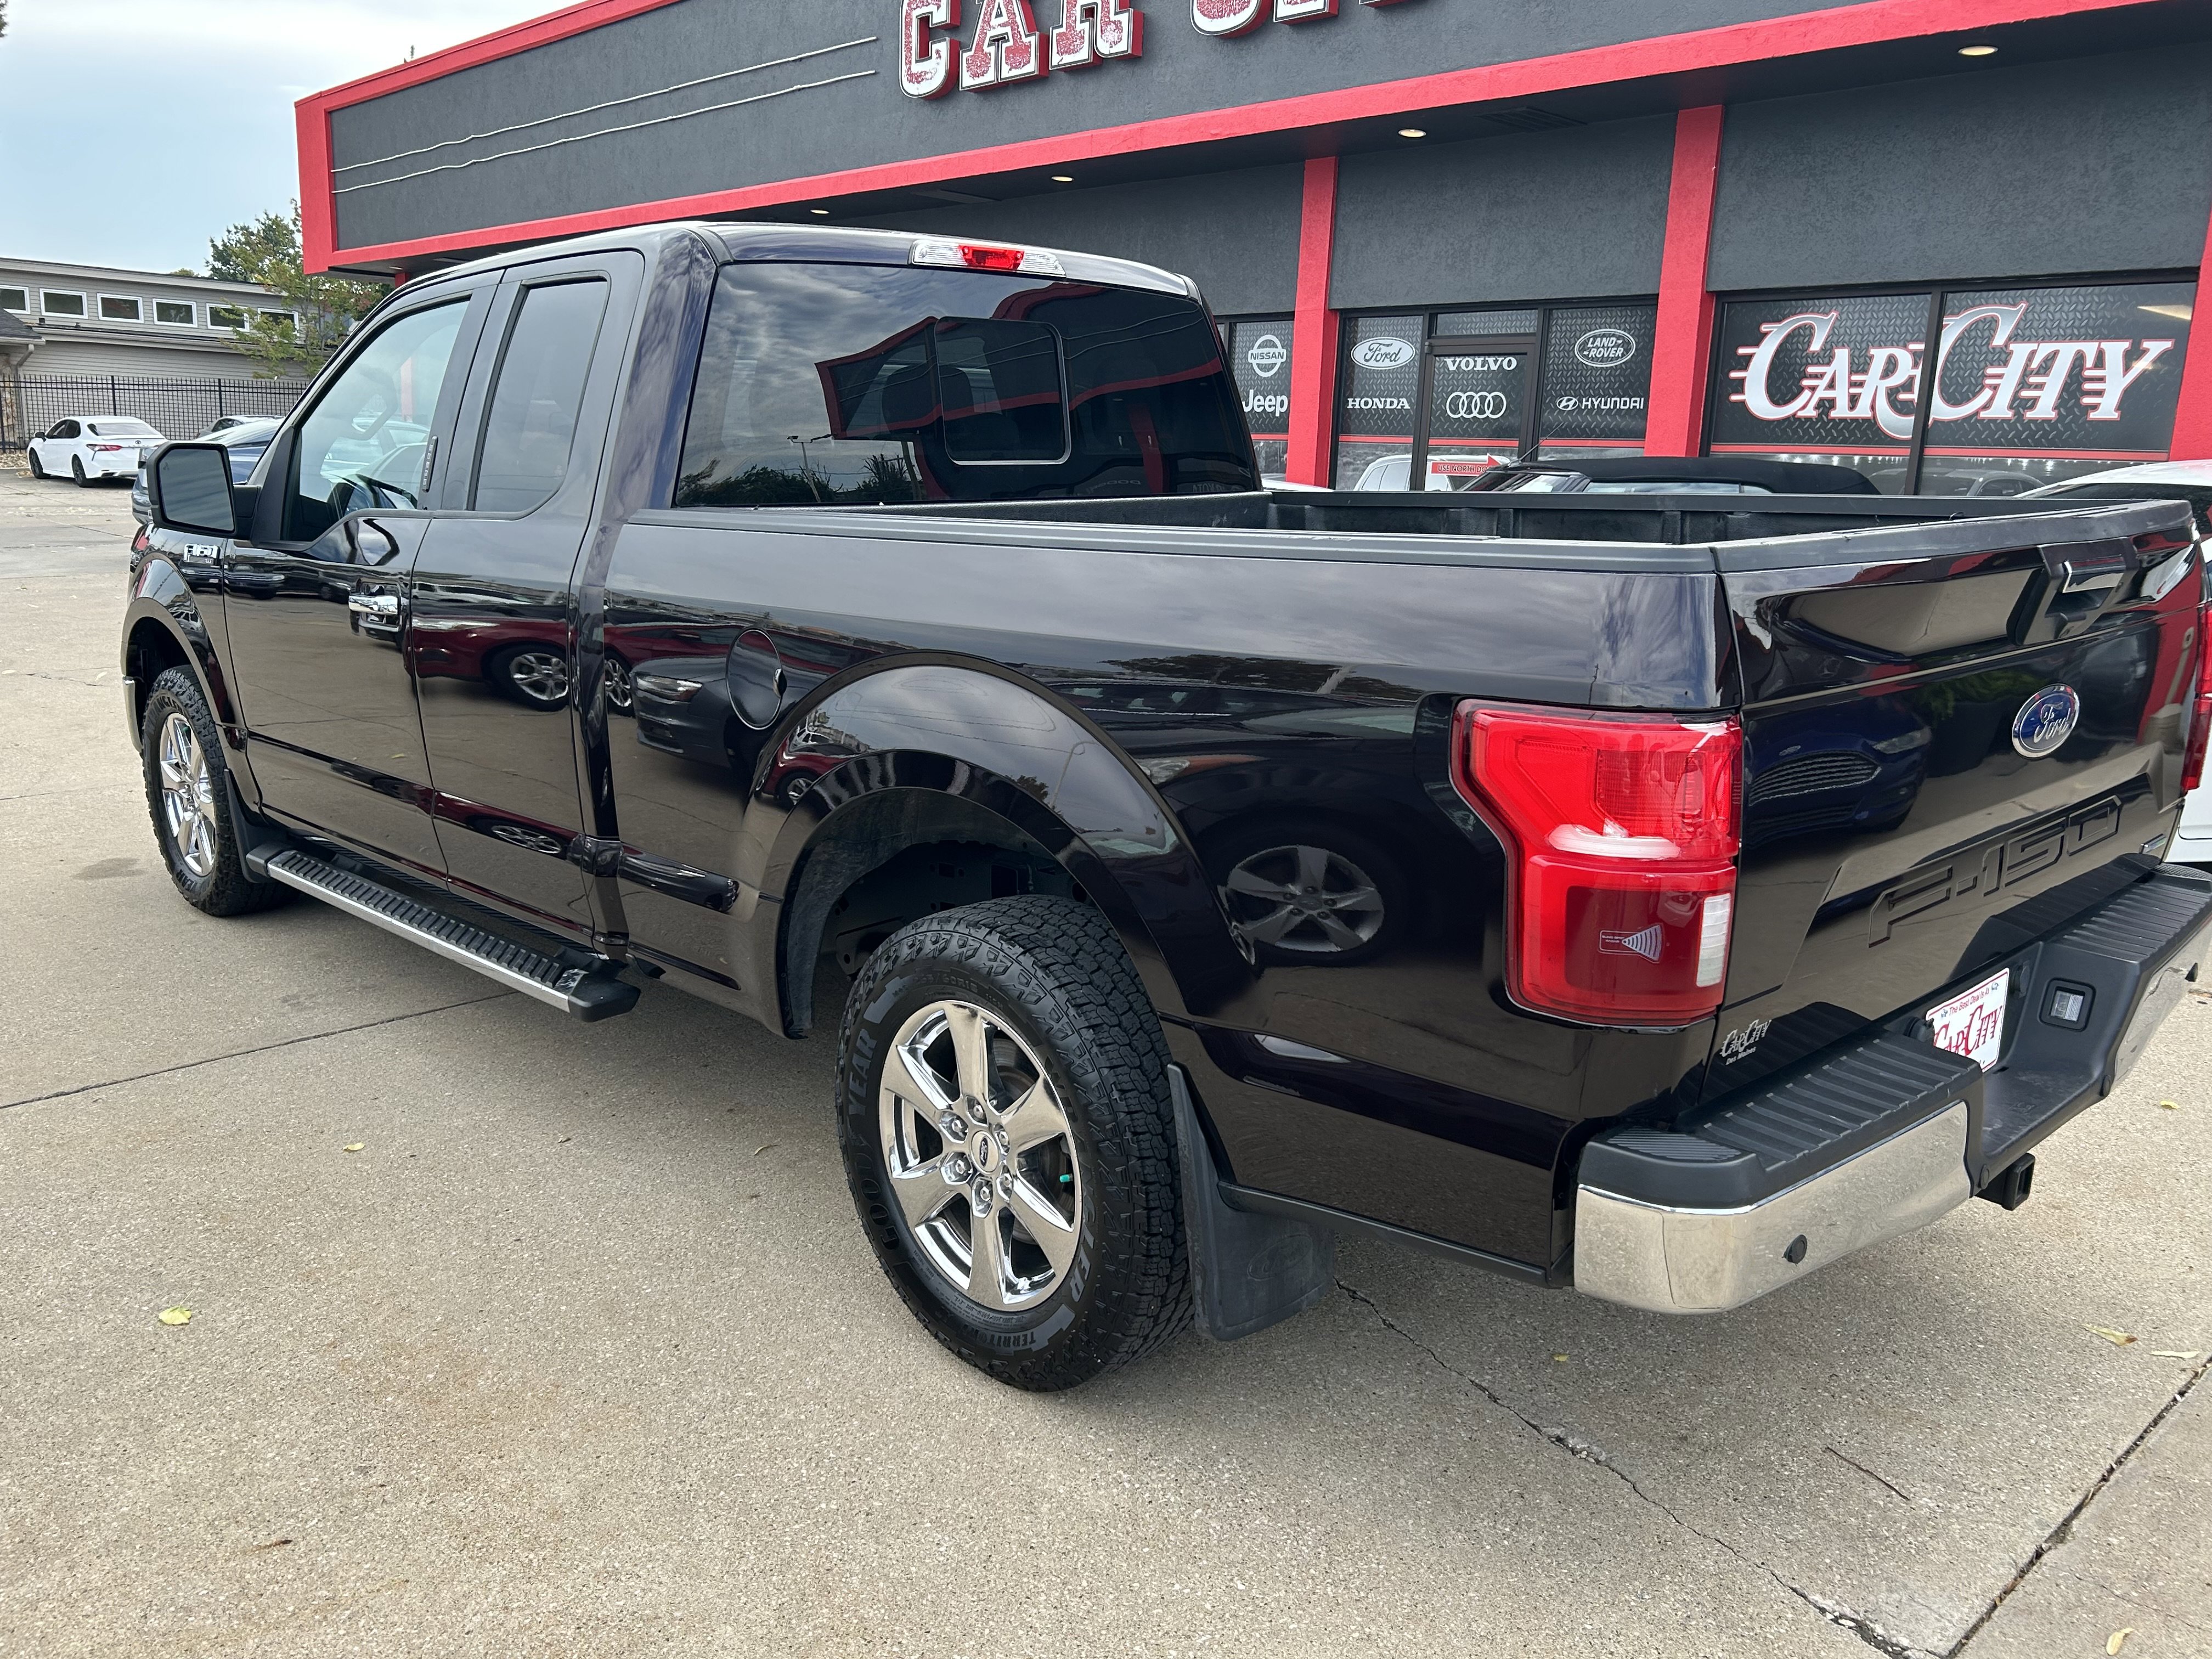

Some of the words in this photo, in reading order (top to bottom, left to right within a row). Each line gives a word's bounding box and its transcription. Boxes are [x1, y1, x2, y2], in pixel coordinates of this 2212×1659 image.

[1250, 352, 1284, 360] NISSAN
[1363, 342, 1402, 363] Ford
[1444, 357, 1517, 371] VOLVO
[1242, 389, 1288, 417] Jeep
[1347, 397, 1411, 409] HONDA
[1582, 397, 1644, 409] HYUNDAI
[2033, 701, 2072, 743] Ford
[1868, 794, 2122, 949] F-150
